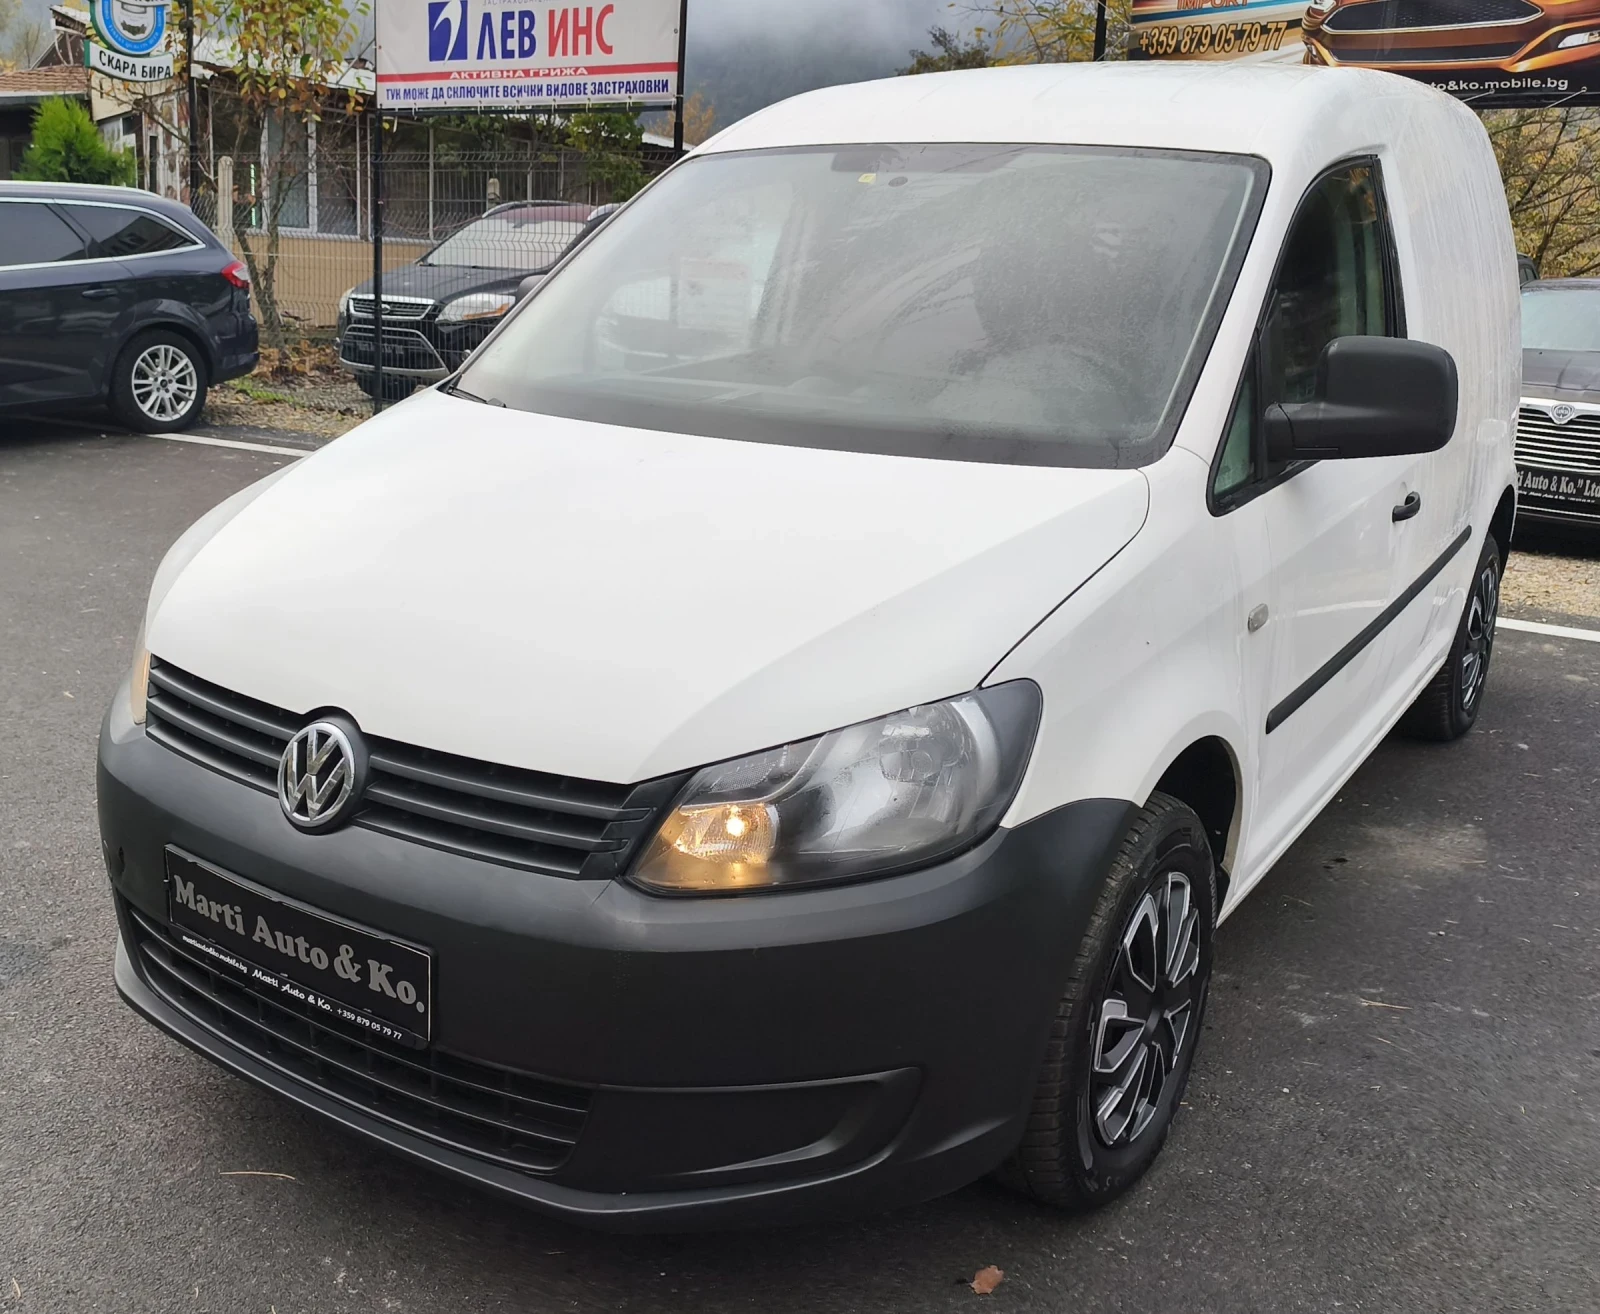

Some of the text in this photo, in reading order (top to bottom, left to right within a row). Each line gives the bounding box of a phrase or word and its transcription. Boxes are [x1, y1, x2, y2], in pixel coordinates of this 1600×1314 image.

[476, 4, 614, 60] ЛЕВ ИНС
[1139, 21, 1287, 55] +359 879 05 79 77
[99, 50, 172, 79] СКАРА БИРА
[449, 66, 588, 80] АКТИВНА ГРИЖА
[386, 79, 669, 101] ТУК МОЖЕ ДА СКЛЮЧИТЕ ВСИЧКИ ВИДОВЕ ЗАСТРАХОВКИ
[1431, 78, 1569, 91] to&ko.mobile.bg
[1524, 471, 1549, 490] Auto
[1550, 475, 1558, 492] &
[173, 875, 425, 1014] Marti Auto & Ko.
[252, 969, 279, 988] Marti
[281, 983, 306, 1000] Auto
[307, 994, 316, 1005] &
[317, 997, 333, 1012] Ko.
[336, 1007, 356, 1021] +359
[356, 1015, 370, 1027] 879
[371, 1022, 381, 1031] 05
[382, 1026, 392, 1036] 79
[393, 1030, 402, 1040] 77
